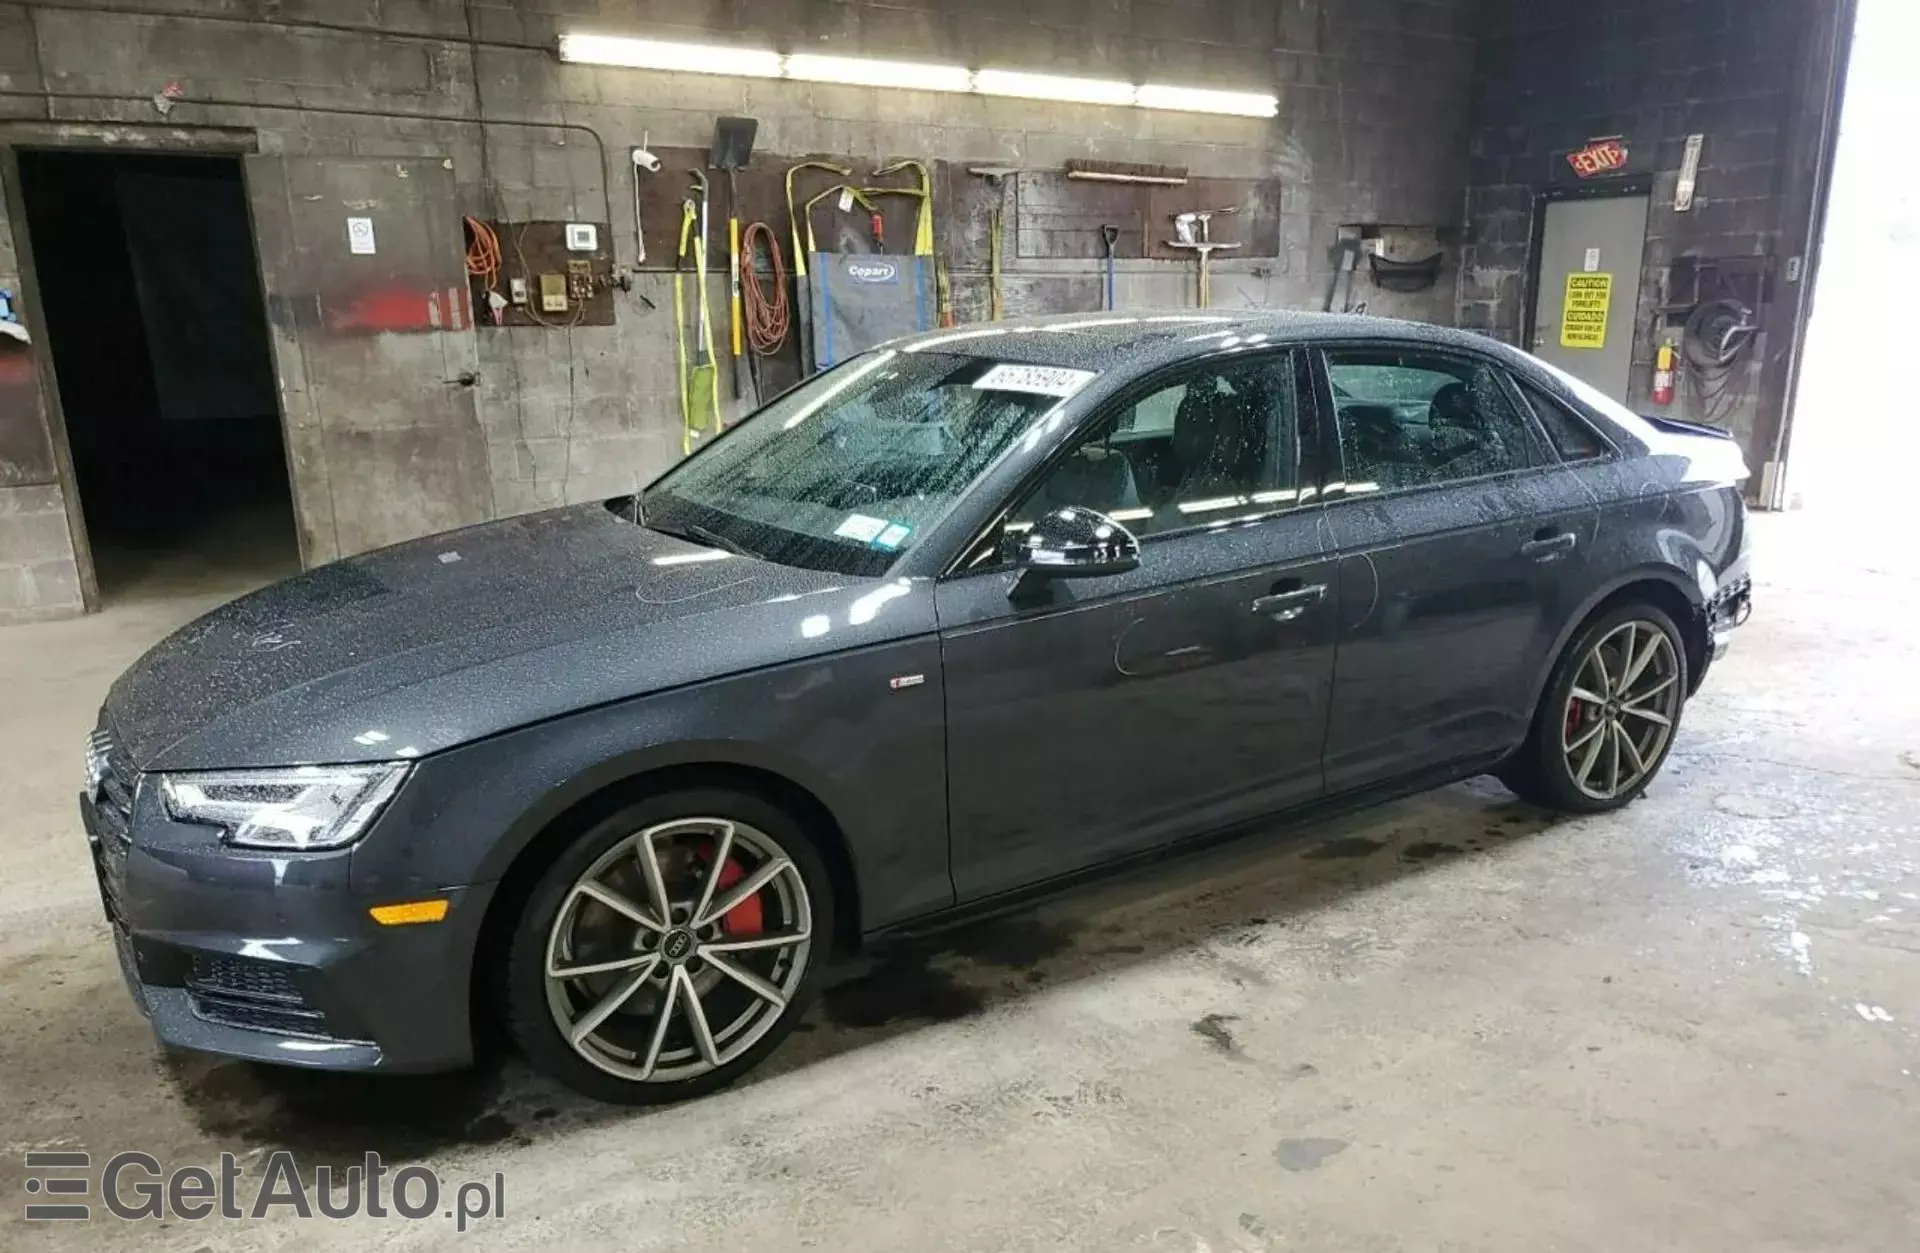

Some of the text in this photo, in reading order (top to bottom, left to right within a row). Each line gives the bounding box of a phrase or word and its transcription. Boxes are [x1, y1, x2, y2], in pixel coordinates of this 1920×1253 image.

[1578, 146, 1616, 172] EXIT
[849, 265, 889, 277] Copart
[1571, 279, 1608, 287] CAUTION
